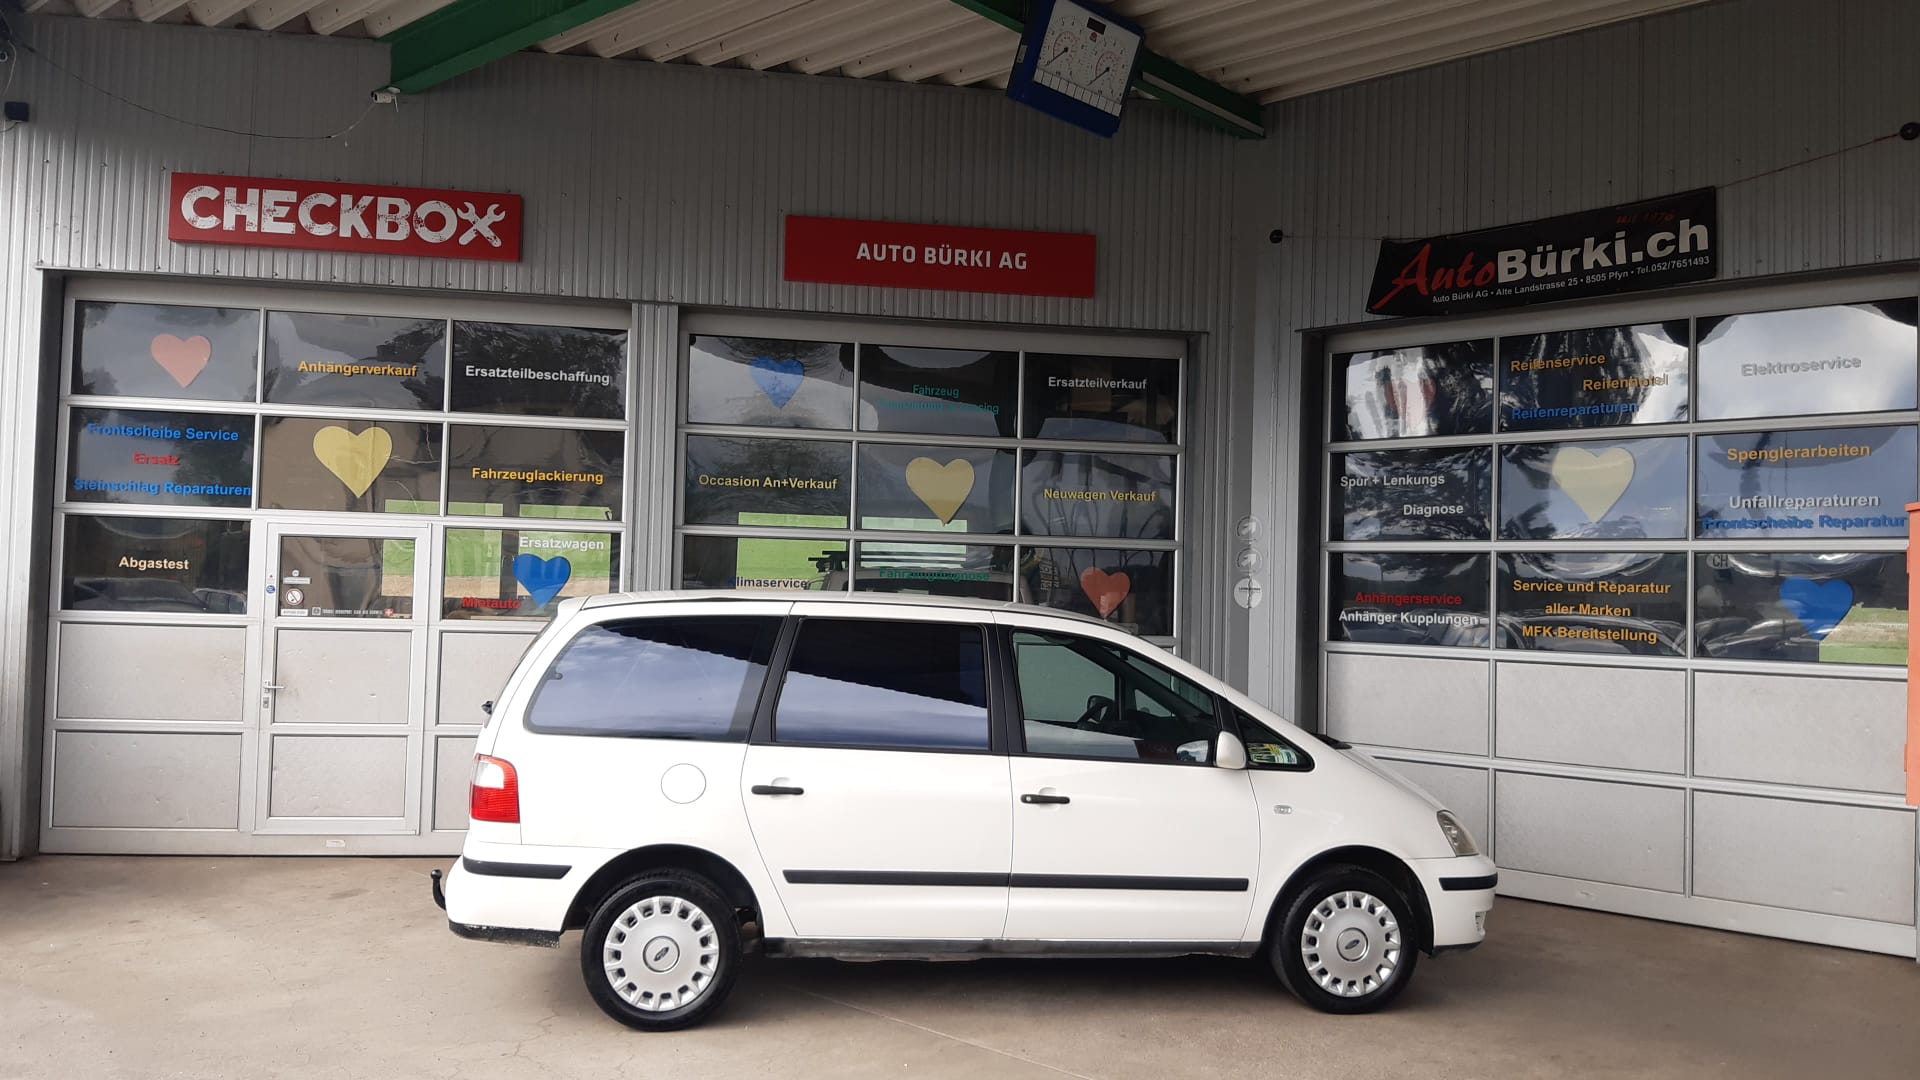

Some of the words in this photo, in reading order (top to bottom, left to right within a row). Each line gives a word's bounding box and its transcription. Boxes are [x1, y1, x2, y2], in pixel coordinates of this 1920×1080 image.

[181, 185, 505, 248] CHECKBOX
[856, 242, 916, 263] AUTO
[924, 244, 991, 268] BÜRKI
[999, 251, 1027, 270] AG
[1433, 295, 1450, 303] Auto
[1452, 290, 1474, 301] Bürki
[1475, 289, 1488, 298] AG
[1496, 288, 1512, 296] Alte
[1515, 279, 1565, 294] Landstrasse
[1568, 277, 1578, 286] 25
[1586, 273, 1607, 284] 8505
[298, 360, 417, 376] Anhängerverkauf
[1511, 353, 1606, 371] Reifenservice
[1741, 356, 1861, 376] Elektroservice
[465, 365, 610, 386] Ersatzteilbeschaffung
[1048, 376, 1147, 389] Ersatzteilverkauf
[912, 384, 960, 398] Fahrzeug
[1512, 402, 1638, 420] Reifenreparaturen
[87, 423, 182, 440] Frontscheibe
[186, 427, 239, 441] Service
[133, 452, 181, 466] Ersatz
[1727, 443, 1871, 463] Spenglerarbeiten
[472, 467, 604, 485] Fahrzeuglackierung
[699, 474, 760, 487] Occasion
[1340, 475, 1368, 488] Spur
[1383, 474, 1445, 488] Lenkungs
[74, 479, 160, 495] Steinschlag
[164, 481, 253, 496] Reparaturen
[1044, 488, 1106, 501] Neuwagen
[1110, 489, 1156, 502] Verkauf
[1729, 494, 1879, 510] Unfallreparaturen
[1403, 503, 1464, 518] Diagnose
[1703, 515, 1814, 530] Frontscheibe
[519, 536, 604, 552] Ersatzwagen
[119, 556, 189, 571] Abgastest
[1712, 553, 1729, 568] CH
[1513, 580, 1563, 592] Service
[1568, 581, 1594, 592] und
[1599, 581, 1671, 595] Reparatur
[463, 596, 522, 610] Mietauto
[1355, 591, 1462, 606] Anhängerservice
[1545, 602, 1575, 615] aller
[1579, 604, 1631, 616] Marken
[1339, 610, 1397, 625] Anhänger
[1401, 611, 1479, 628] Kupplungen
[1522, 625, 1657, 644] MFK-Bereitstellung
